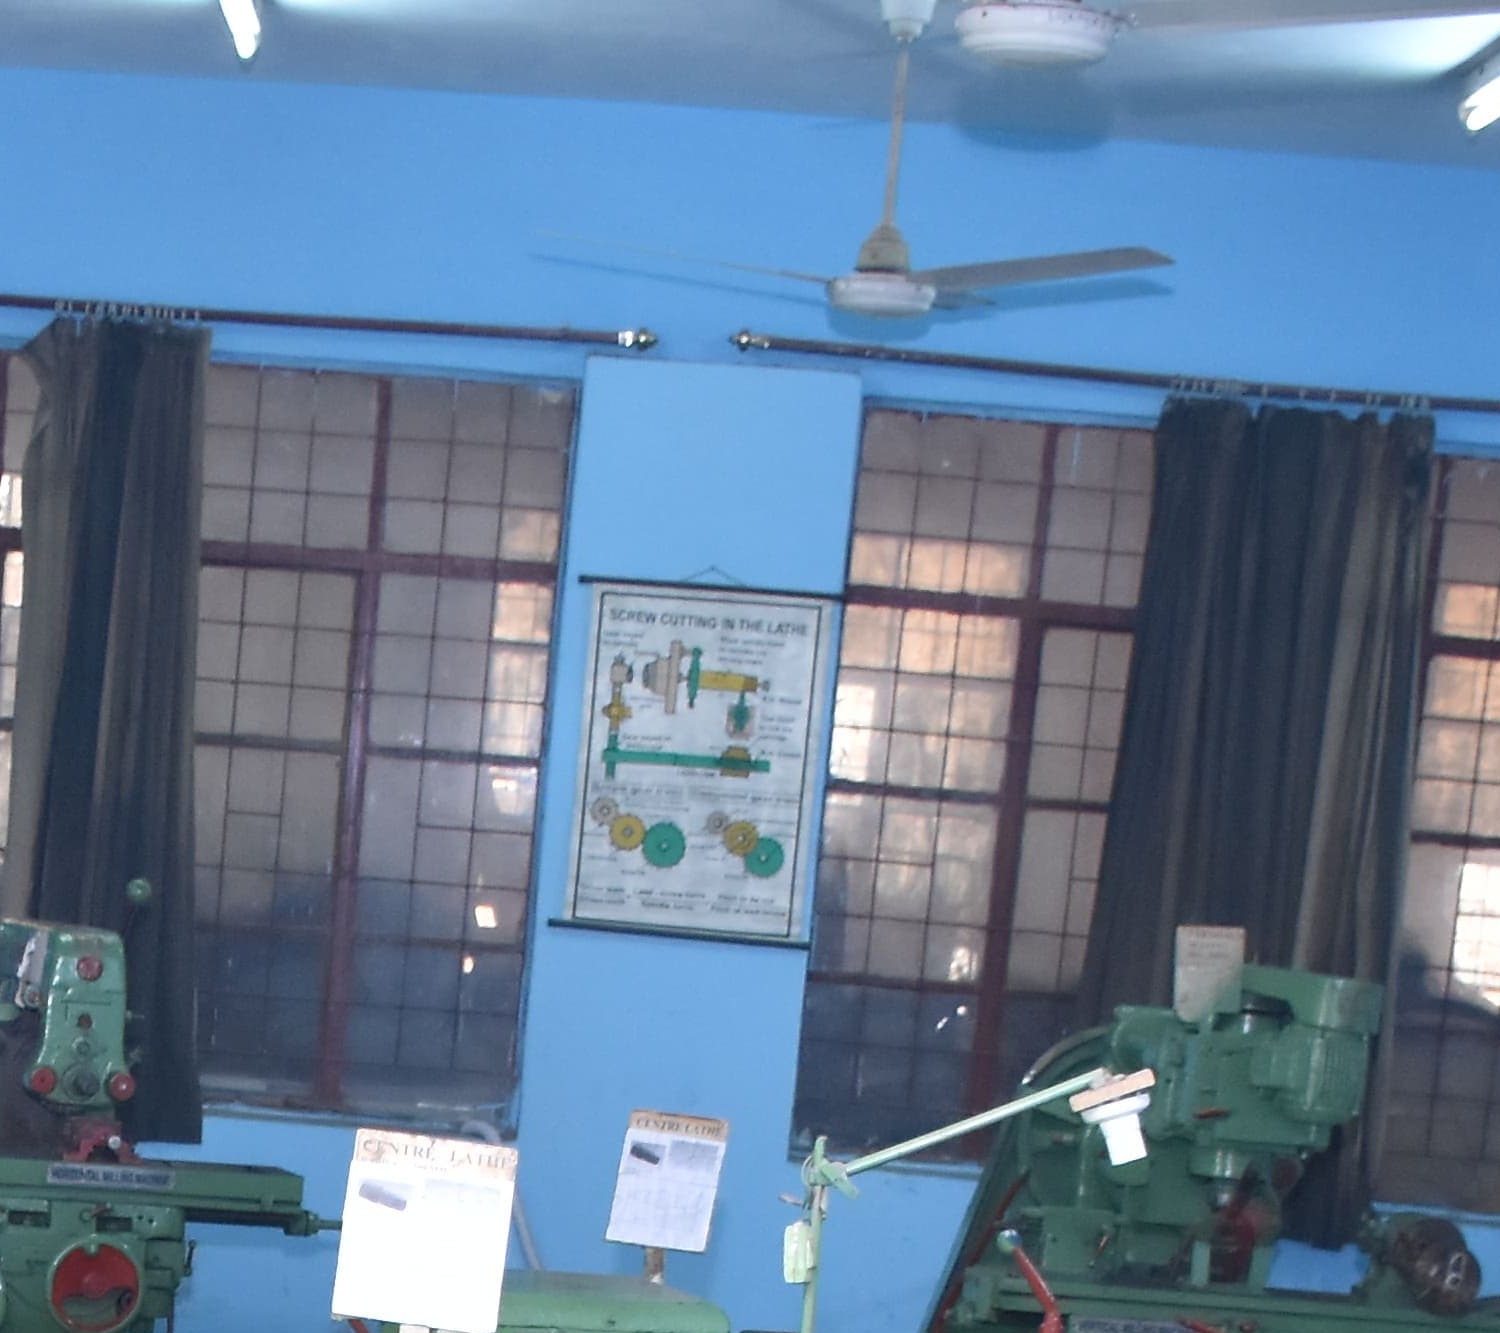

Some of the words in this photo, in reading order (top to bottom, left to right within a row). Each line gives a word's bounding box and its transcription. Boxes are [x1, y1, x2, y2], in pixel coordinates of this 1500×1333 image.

[608, 608, 657, 625] SCREW
[659, 610, 717, 630] CUTTING
[721, 617, 736, 631] IN
[738, 618, 763, 633] THE
[767, 620, 809, 637] LATHE
